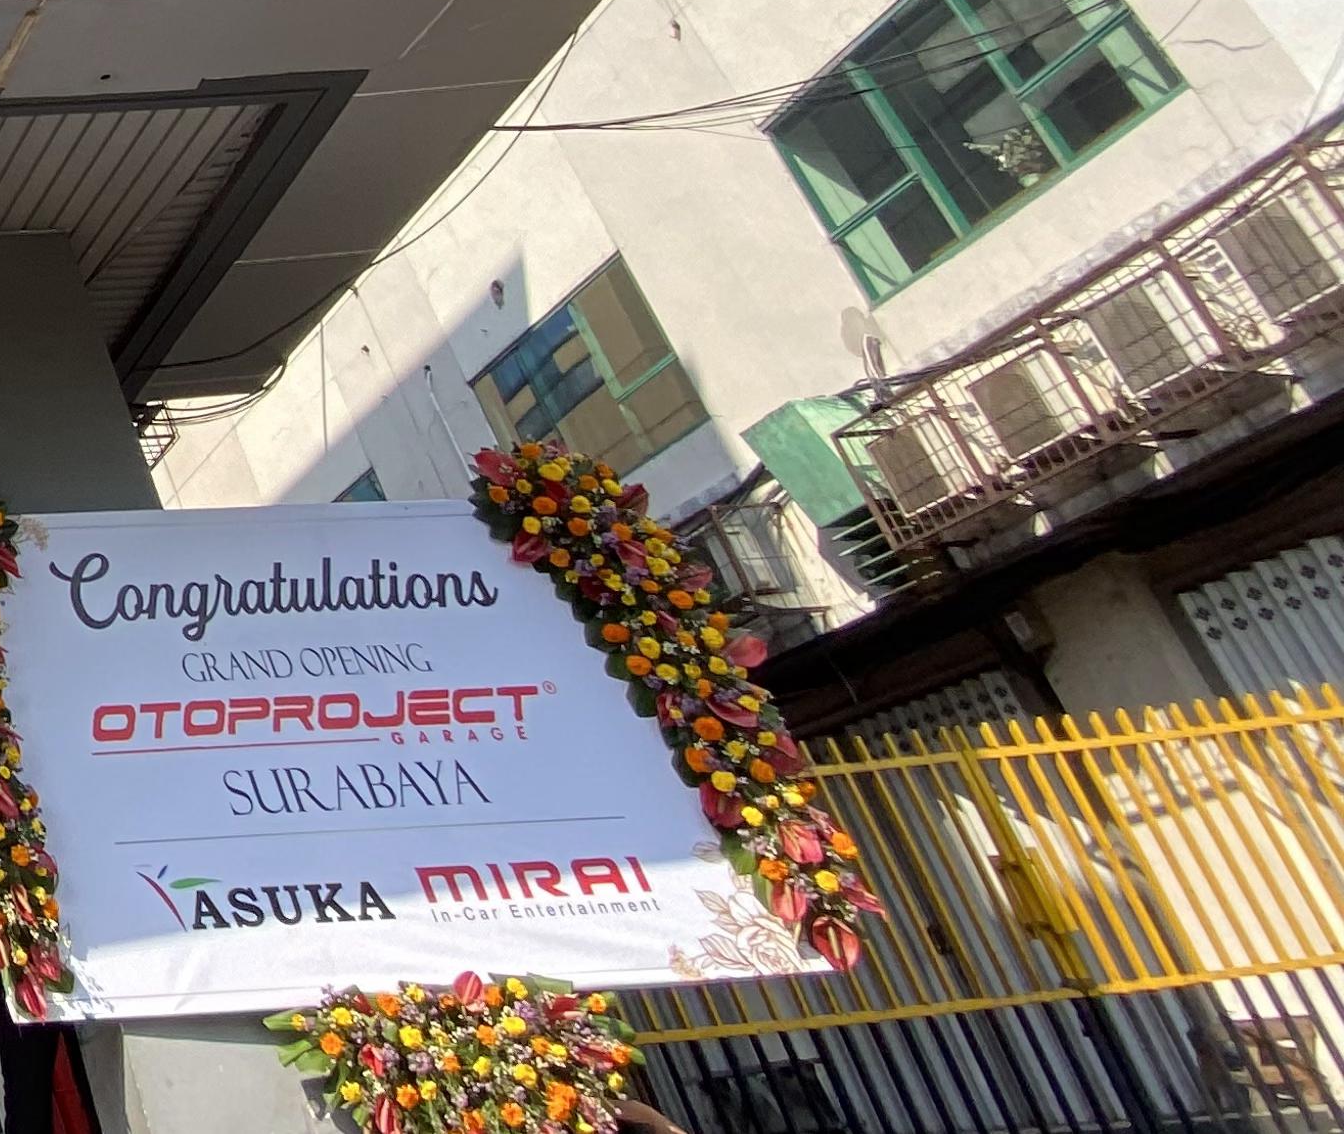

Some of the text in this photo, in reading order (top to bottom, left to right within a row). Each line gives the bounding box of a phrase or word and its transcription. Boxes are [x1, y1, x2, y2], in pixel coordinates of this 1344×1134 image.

[49, 552, 499, 642] Congratulations
[181, 642, 435, 683] GRAND OPENING
[92, 685, 540, 743] OTOPROJECT
[392, 724, 530, 746] GARAGE
[221, 759, 493, 817] SURABAYA
[191, 855, 653, 930] ASUKA MIRAI
[431, 897, 661, 923] In-Car Entertainment
